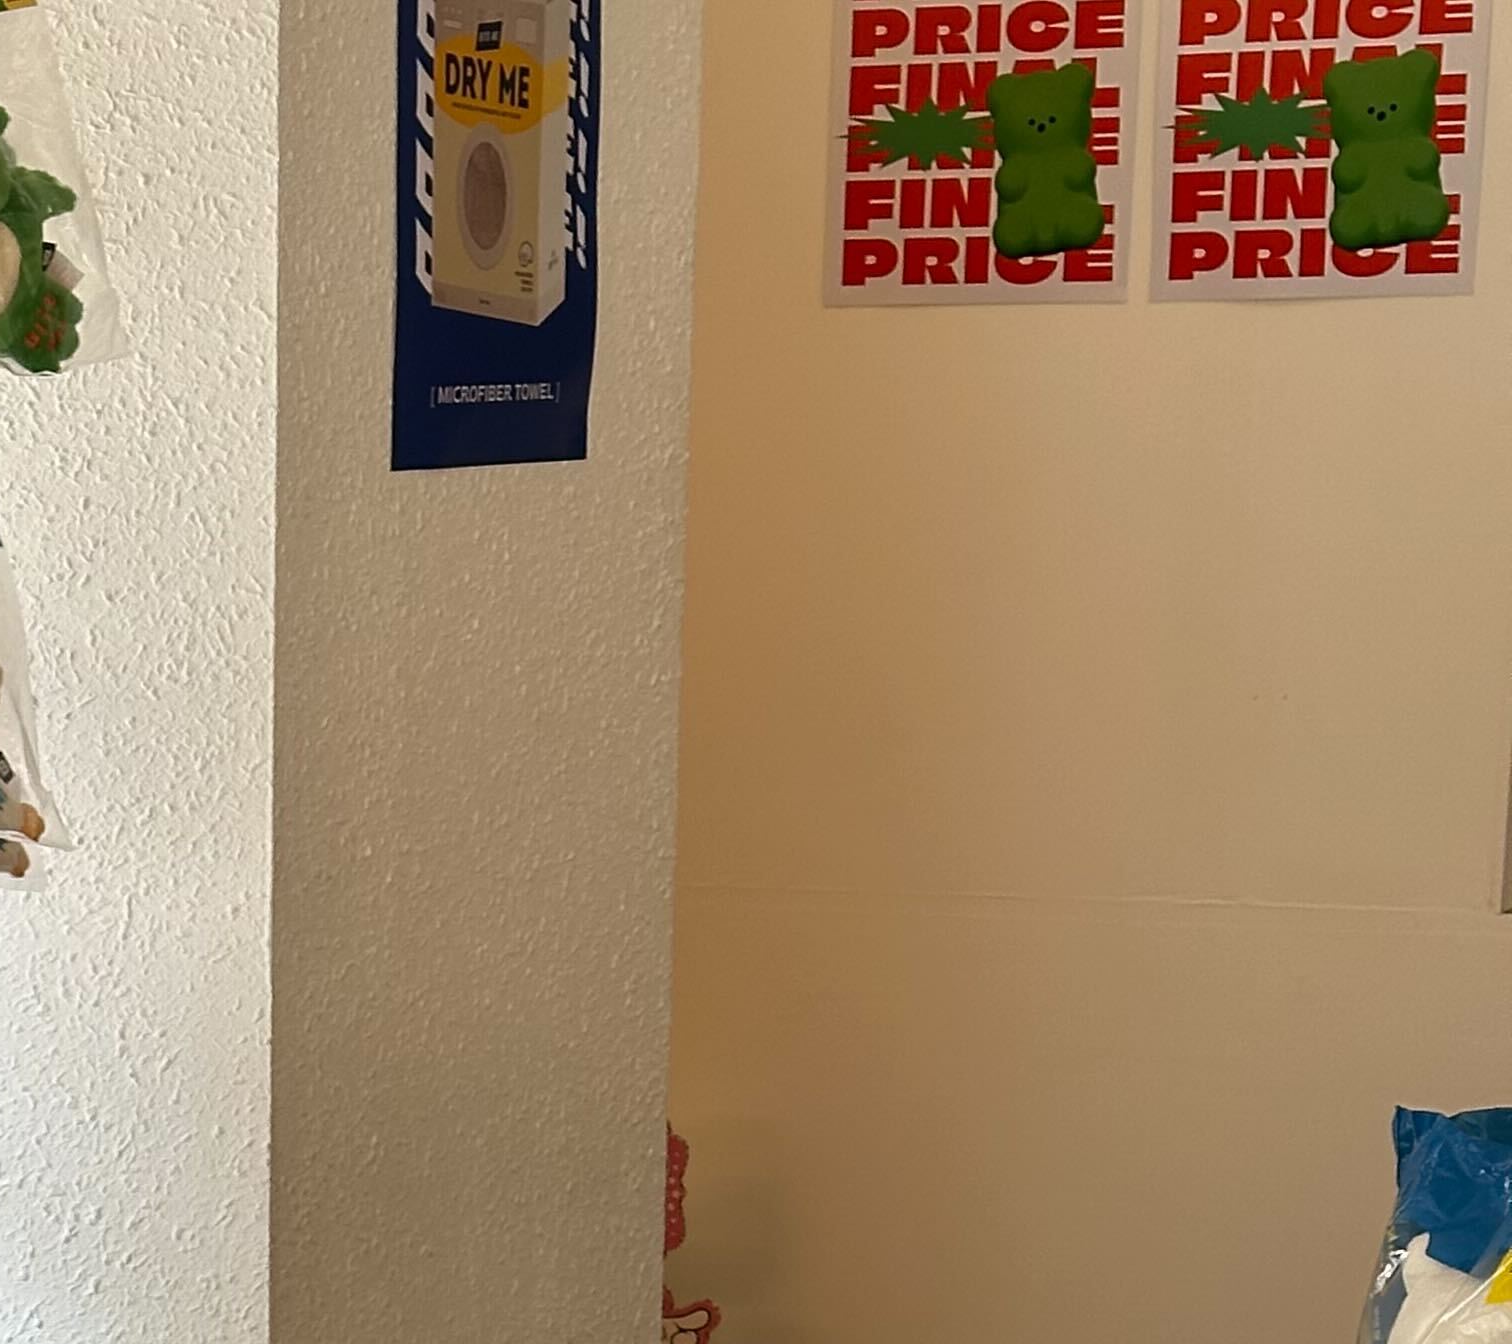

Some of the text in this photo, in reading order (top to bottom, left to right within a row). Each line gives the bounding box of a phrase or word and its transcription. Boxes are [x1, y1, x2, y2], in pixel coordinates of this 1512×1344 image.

[851, 0, 1126, 57] PRICE
[1179, 0, 1474, 45] PRICE
[444, 52, 531, 109] DRY ME
[849, 58, 1121, 116] FIN
[1175, 43, 1468, 105] FIN
[437, 382, 555, 405] MICROFIBER TOWEL
